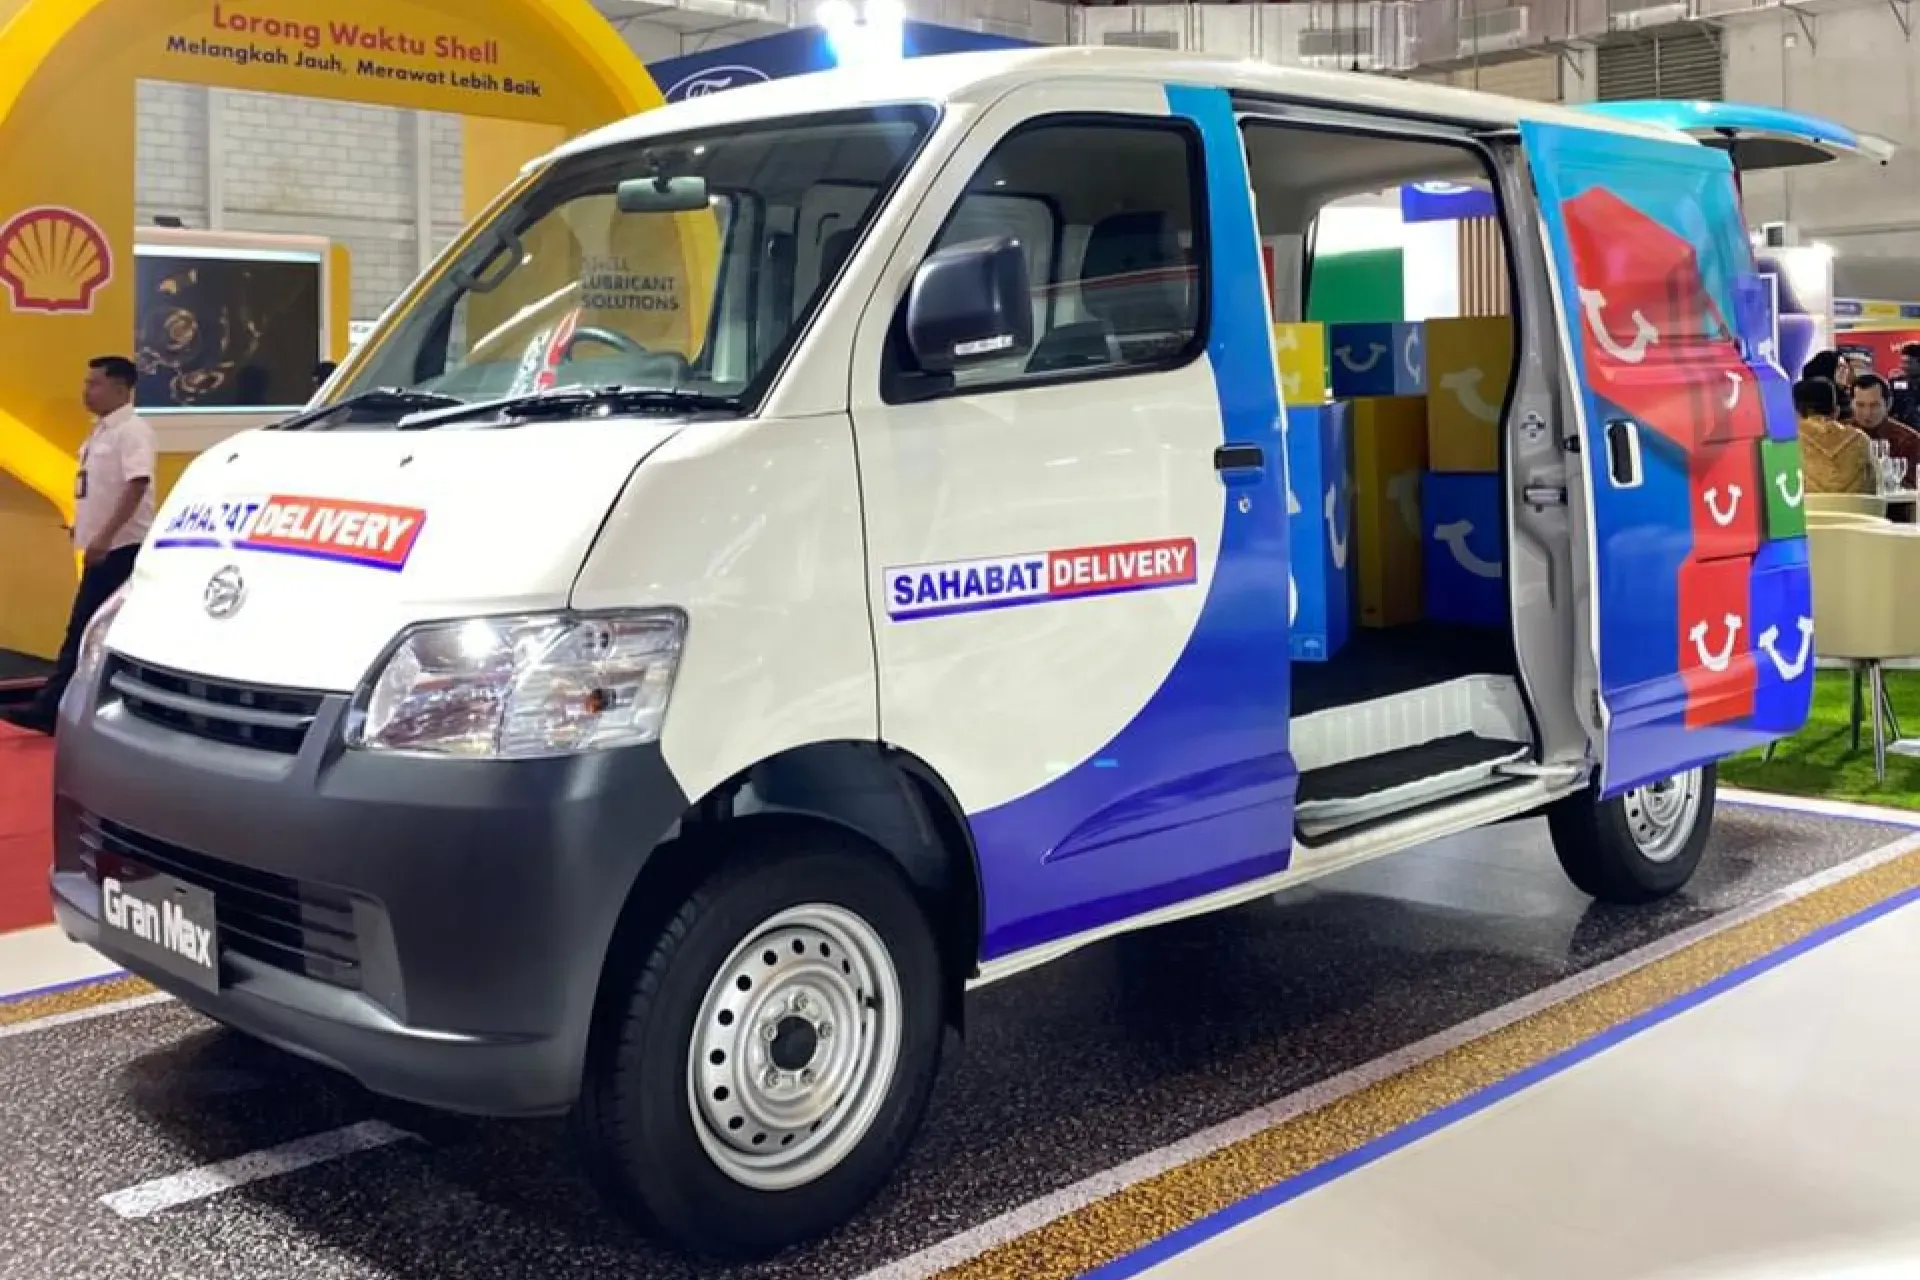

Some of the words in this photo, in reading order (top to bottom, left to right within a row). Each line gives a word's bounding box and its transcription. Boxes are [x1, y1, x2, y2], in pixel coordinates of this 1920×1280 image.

[213, 3, 321, 49] Lorong
[329, 20, 425, 56] Waktu
[434, 34, 499, 65] Shell
[166, 35, 289, 66] Melangkah
[357, 58, 446, 85] Merawat
[451, 69, 498, 91] Lebih
[503, 75, 541, 97] Baik
[582, 274, 676, 291] LUBRICANT
[582, 293, 680, 310] SOLUTIONS
[256, 503, 414, 553] DELIVERY
[893, 560, 1043, 606] SAHABAT
[1053, 545, 1189, 587] DELIVERY
[103, 876, 160, 945] Gran
[162, 898, 212, 969] Max
